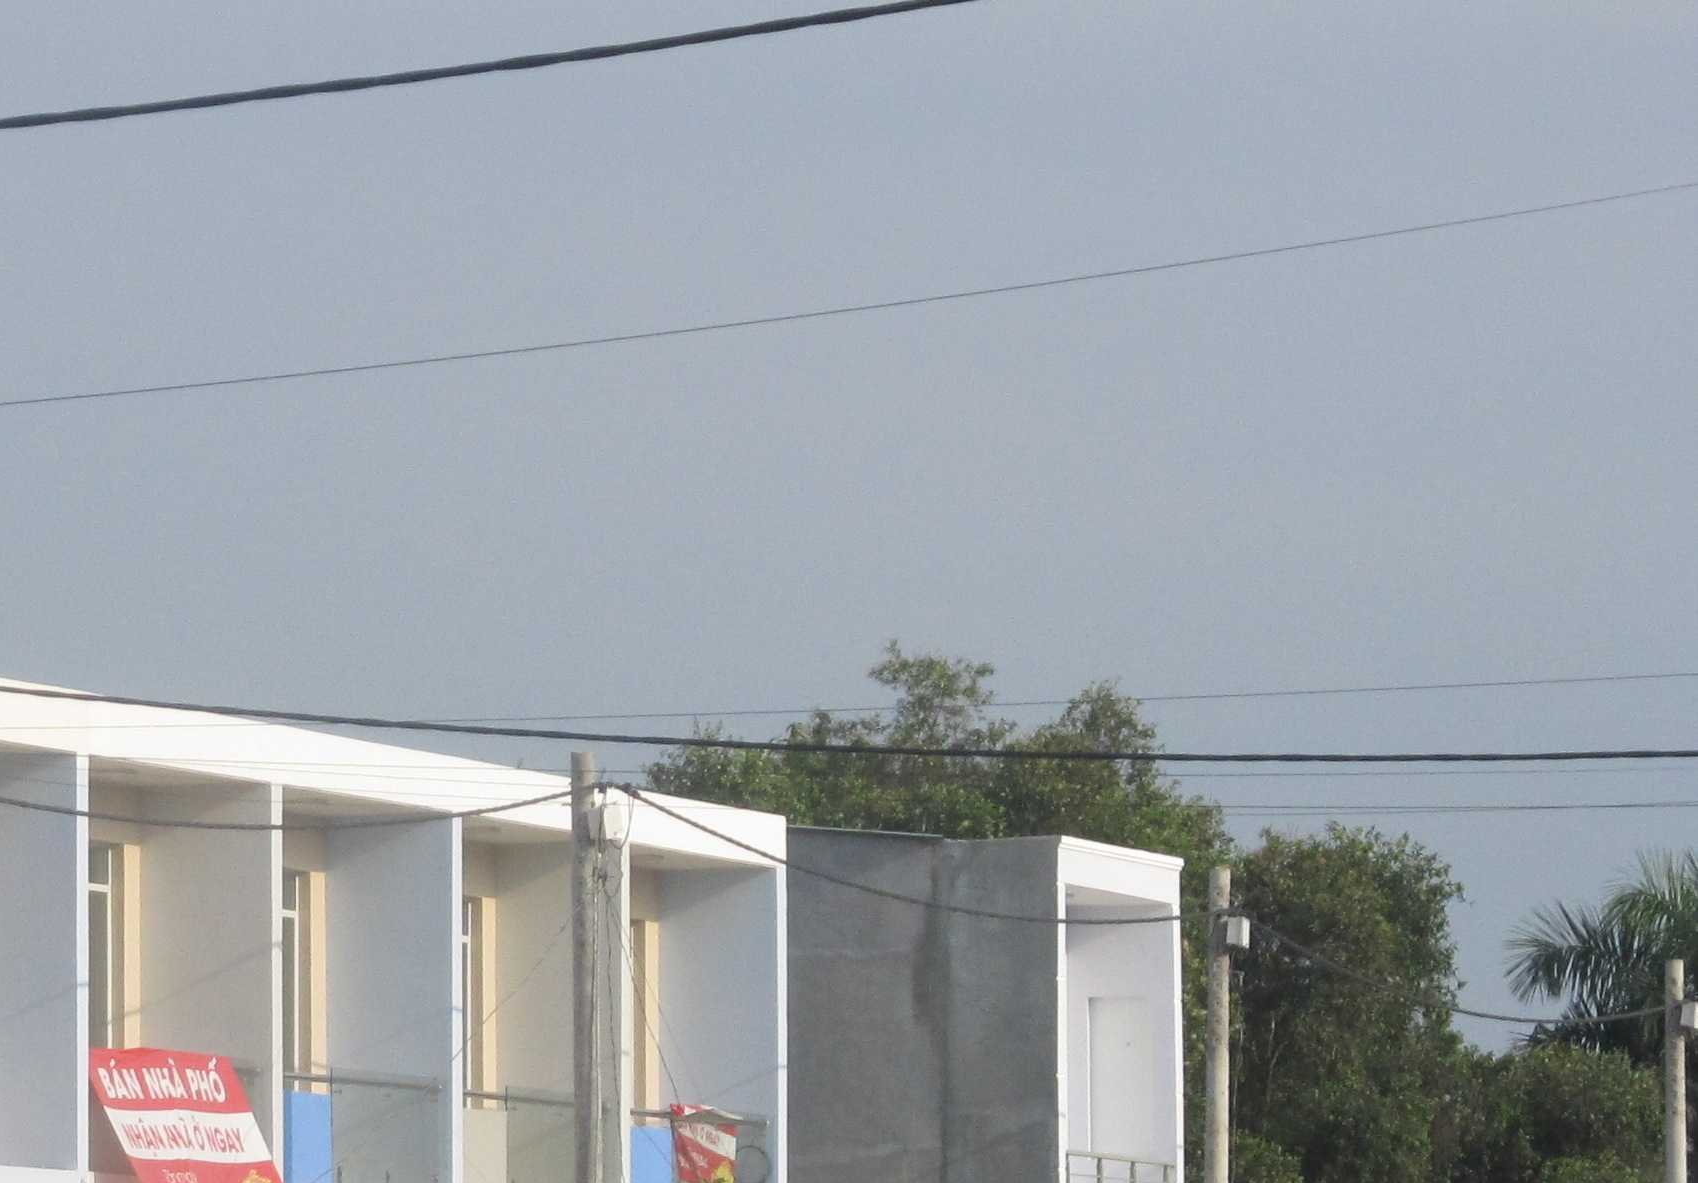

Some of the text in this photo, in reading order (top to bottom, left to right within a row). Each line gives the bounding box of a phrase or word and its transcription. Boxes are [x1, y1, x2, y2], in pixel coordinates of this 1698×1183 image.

[98, 1057, 227, 1103] BÁN NHÀ PHỐ
[205, 1125, 245, 1153] NGAY
